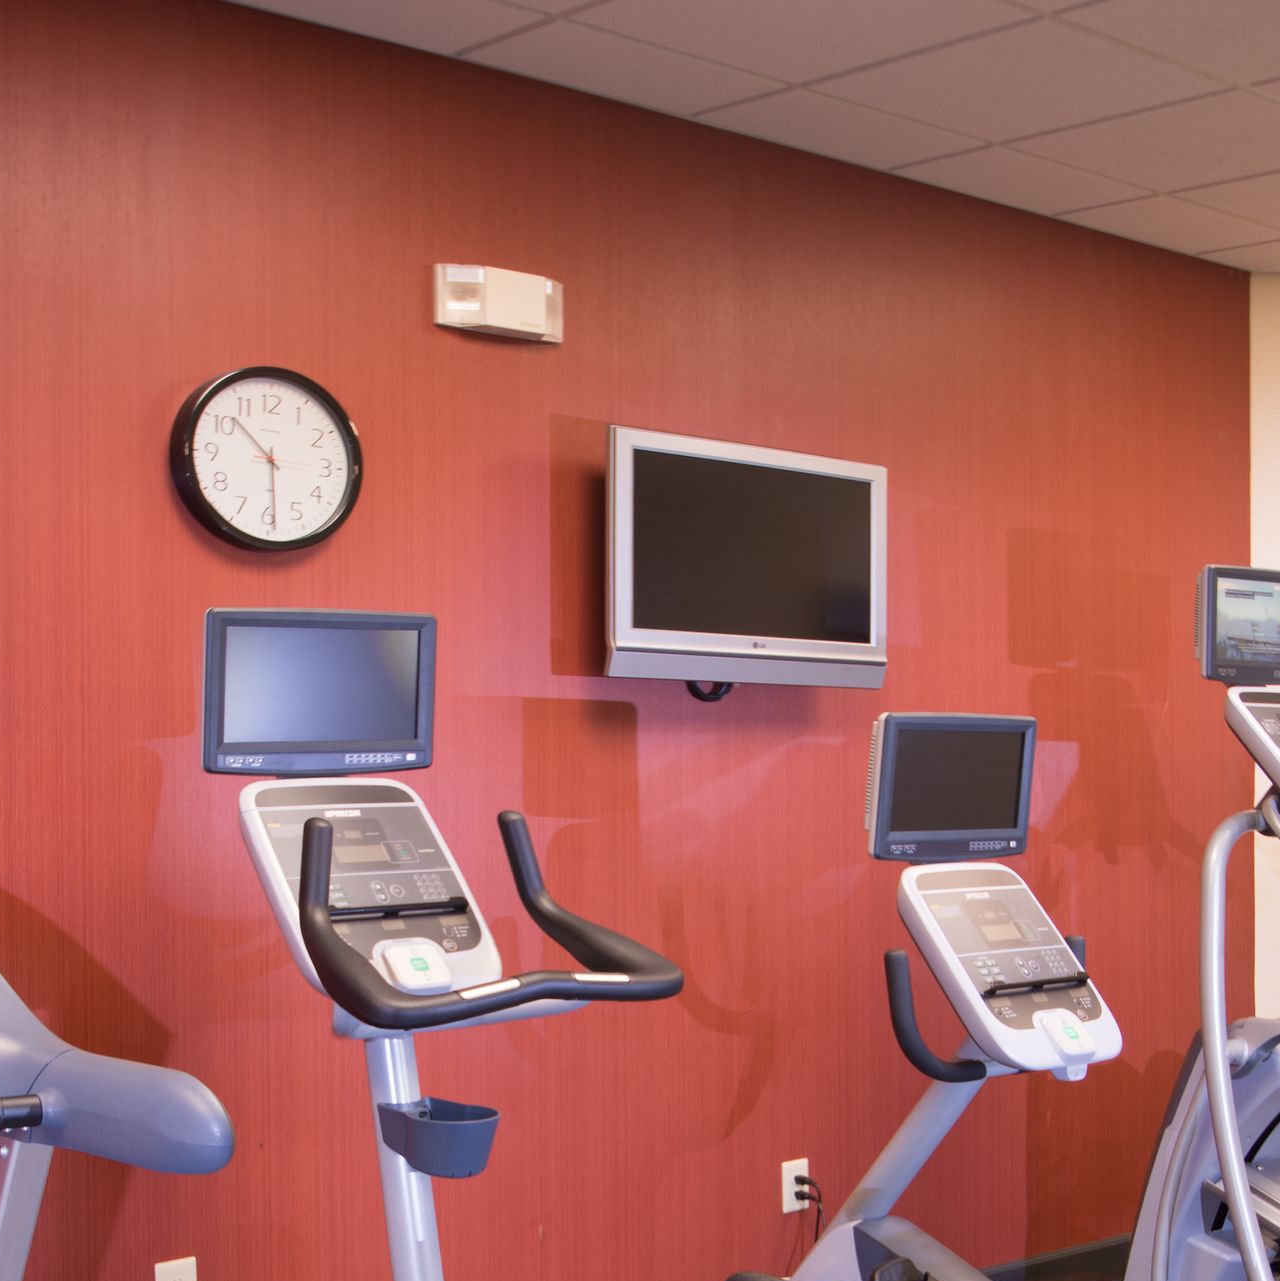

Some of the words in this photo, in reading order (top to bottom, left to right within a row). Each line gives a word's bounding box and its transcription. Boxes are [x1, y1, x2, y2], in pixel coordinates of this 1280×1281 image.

[237, 397, 251, 417] 11
[263, 394, 281, 415] 12
[214, 414, 236, 436] 10
[296, 406, 301, 425] 1
[311, 429, 325, 448] 2
[205, 442, 219, 462] 9
[320, 458, 332, 478] 3
[213, 471, 228, 491] 8
[310, 485, 322, 504] 4
[235, 496, 248, 515] 7
[261, 505, 275, 526] 6
[290, 502, 303, 521] 5
